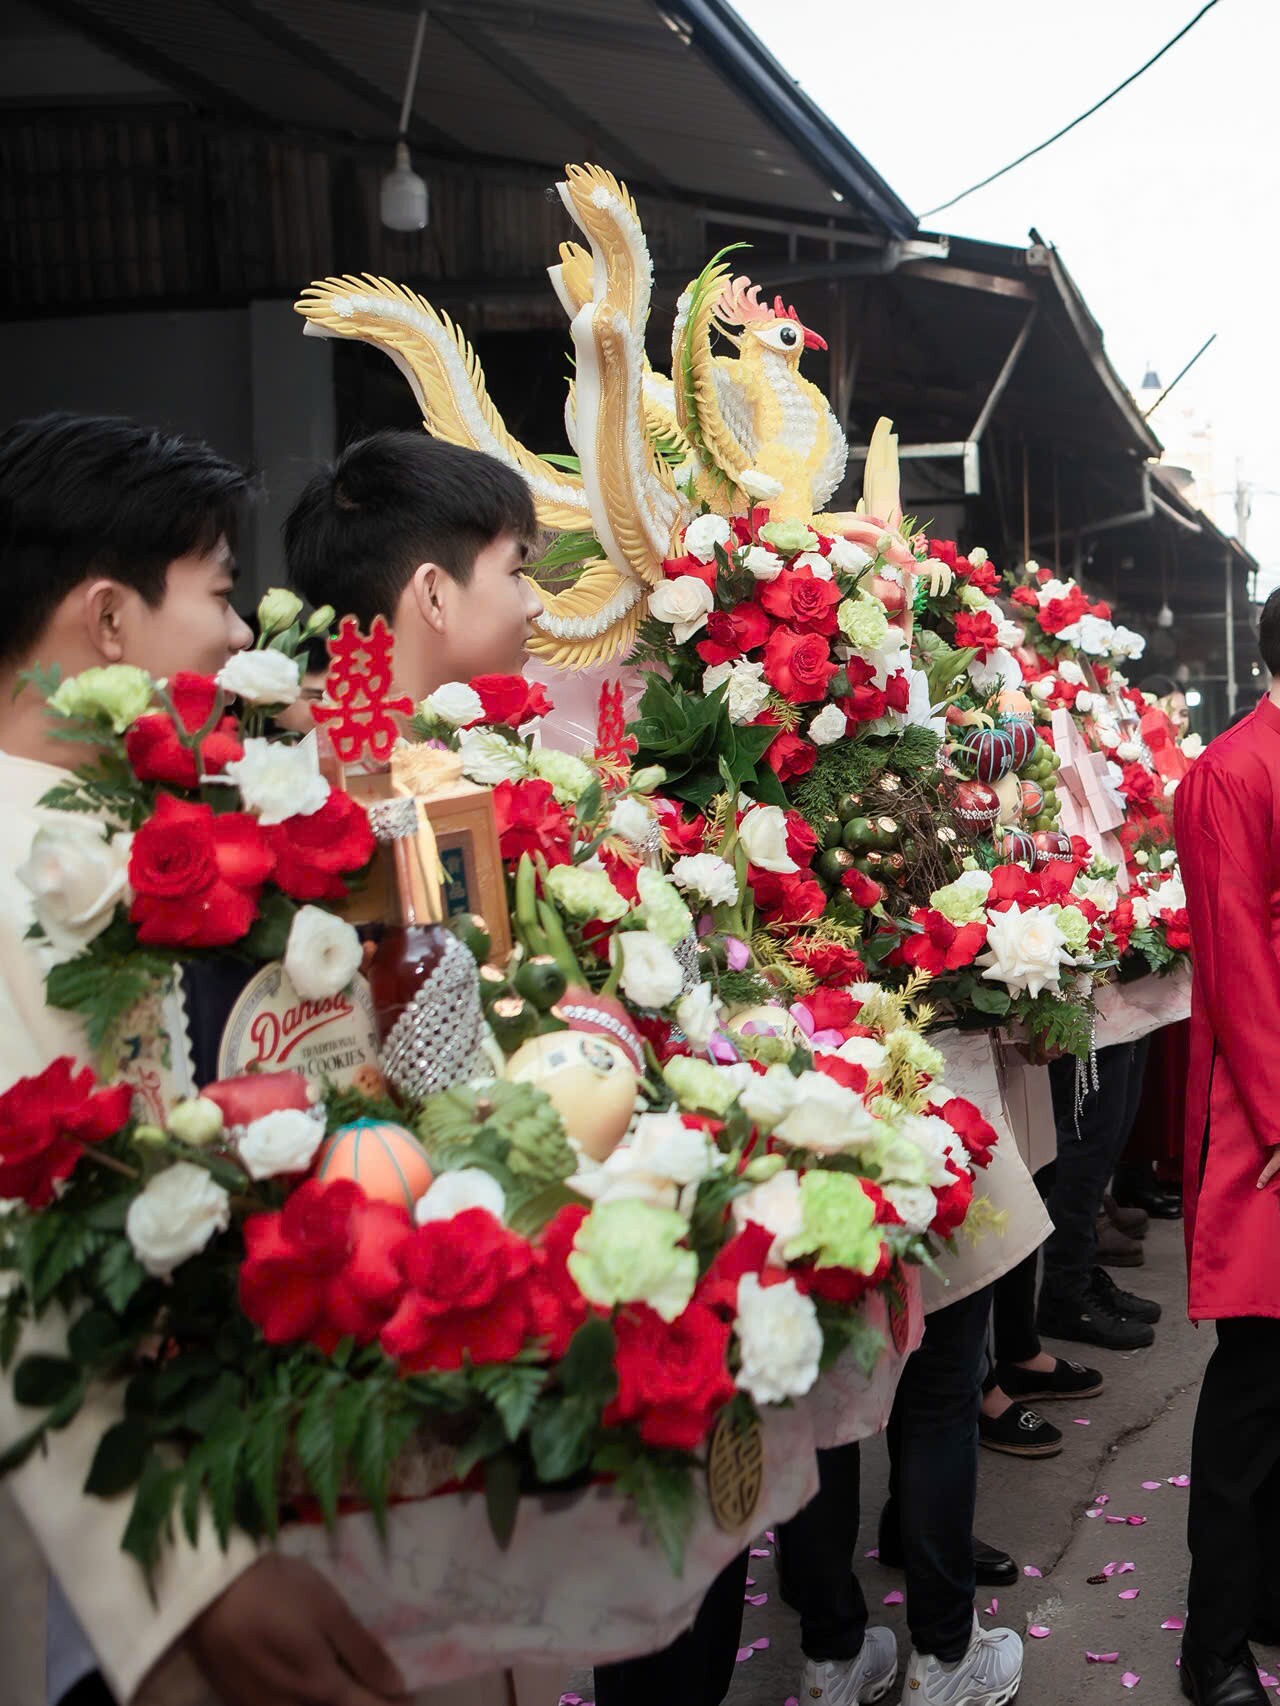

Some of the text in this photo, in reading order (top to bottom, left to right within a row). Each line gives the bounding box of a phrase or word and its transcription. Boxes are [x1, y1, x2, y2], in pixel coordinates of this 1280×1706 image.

[246, 993, 353, 1072] Danisa
[303, 1037, 356, 1057] TRADITIONAL
[309, 1050, 365, 1075] COOKIES
